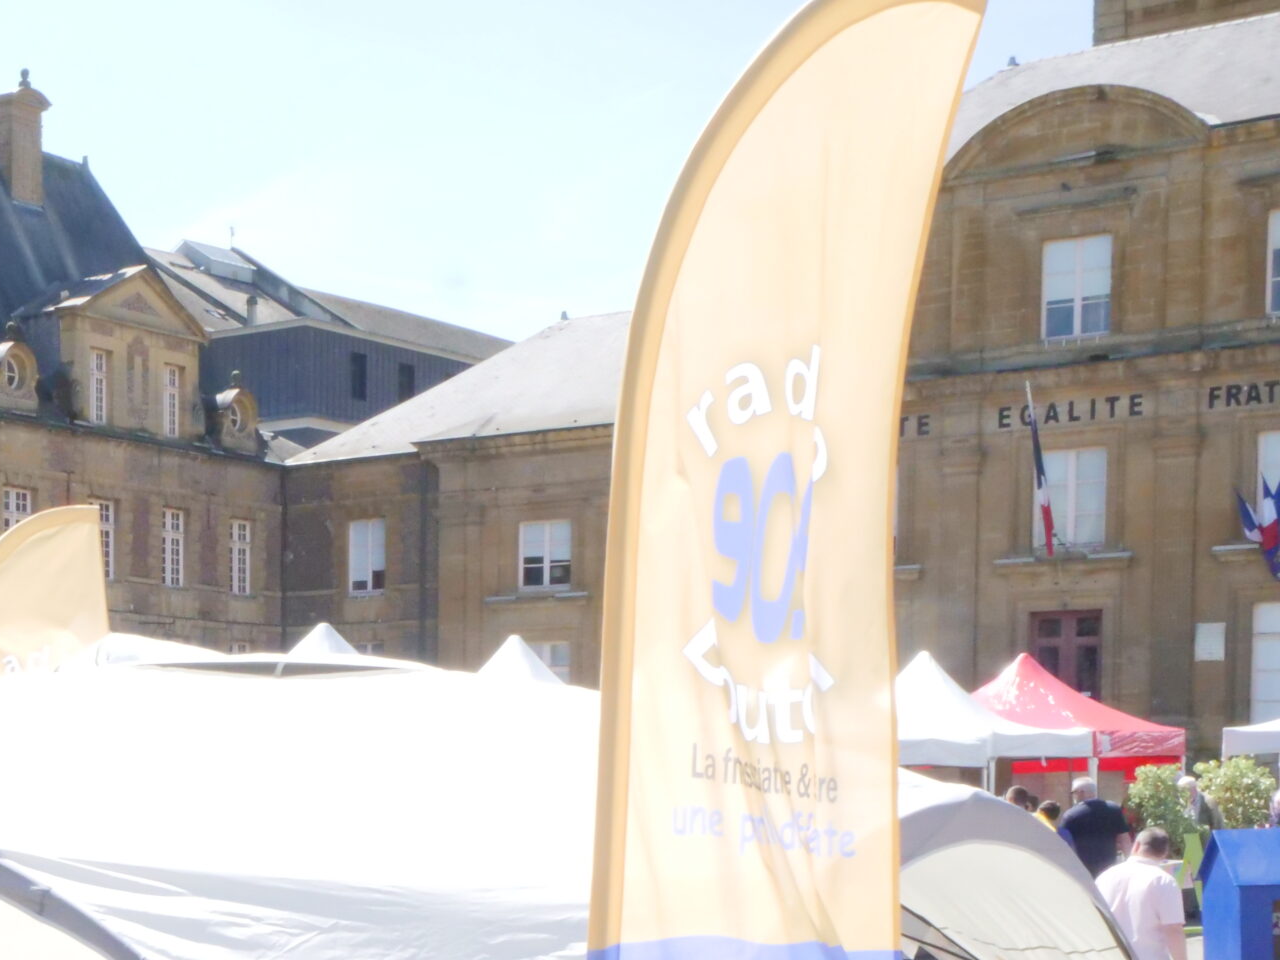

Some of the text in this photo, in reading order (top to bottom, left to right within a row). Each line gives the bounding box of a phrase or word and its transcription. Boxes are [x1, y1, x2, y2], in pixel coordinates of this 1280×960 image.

[998, 393, 1143, 428] EGALITE
[691, 743, 717, 780] La
[673, 805, 725, 836] une
